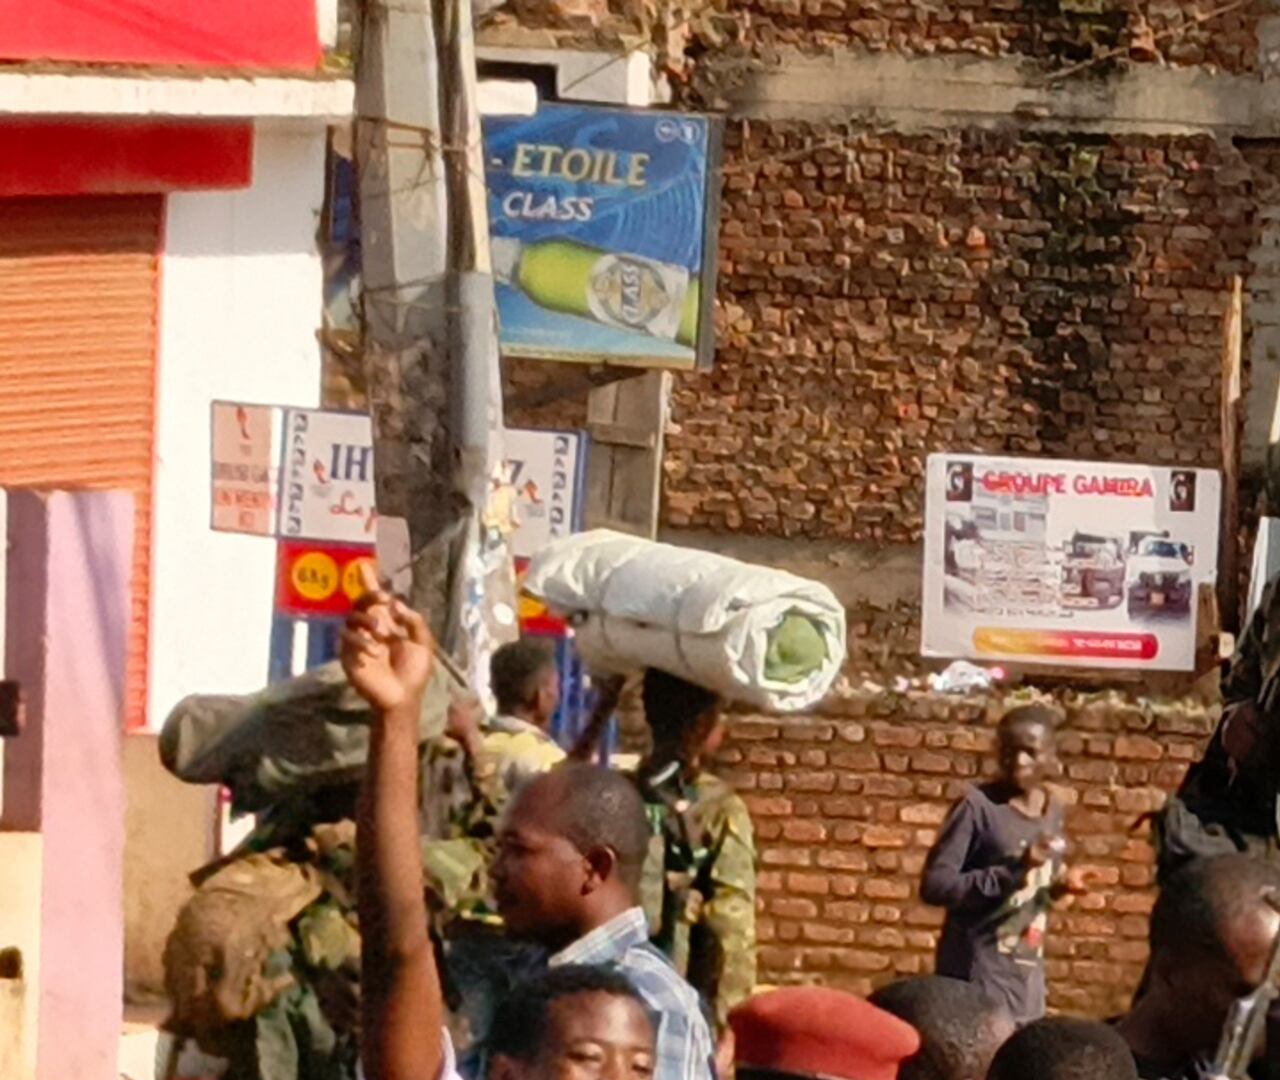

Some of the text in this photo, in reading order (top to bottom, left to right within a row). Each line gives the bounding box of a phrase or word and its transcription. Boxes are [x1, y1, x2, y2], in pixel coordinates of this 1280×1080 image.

[511, 142, 650, 187] ETOILE
[502, 191, 594, 222] CLASS
[981, 470, 1067, 496] GROUPE
